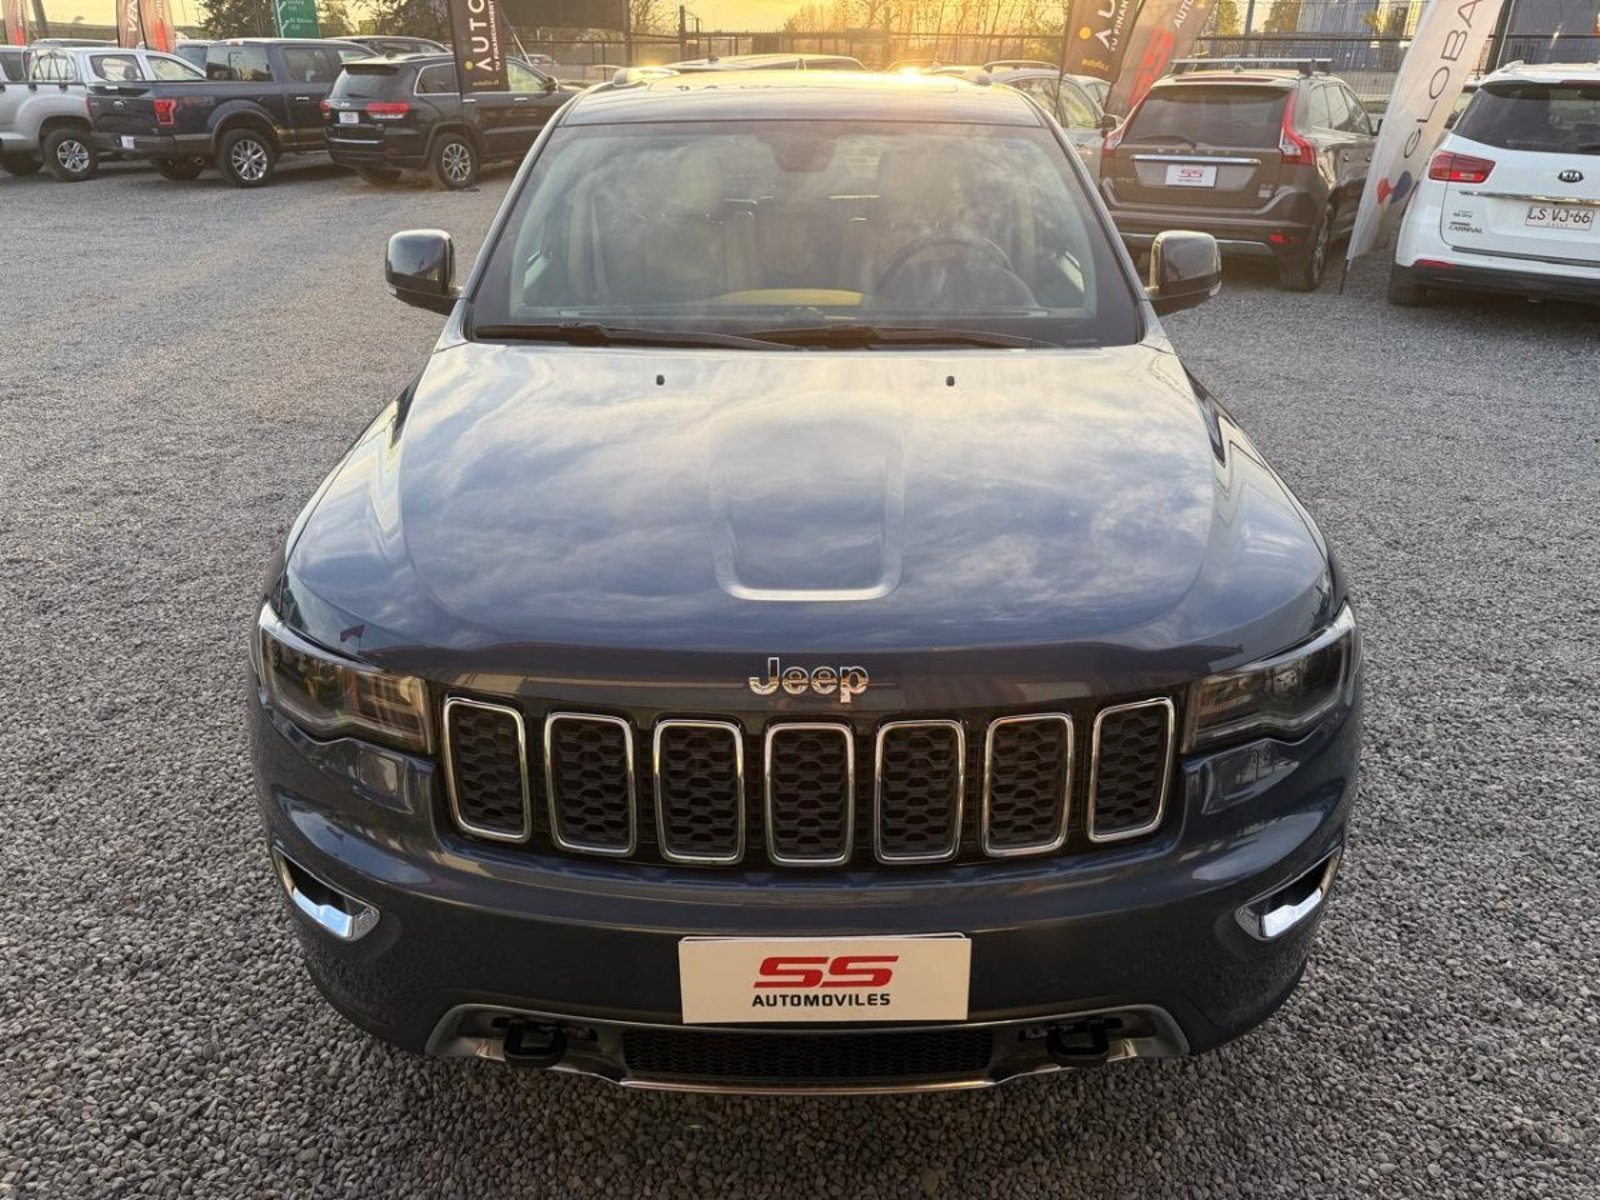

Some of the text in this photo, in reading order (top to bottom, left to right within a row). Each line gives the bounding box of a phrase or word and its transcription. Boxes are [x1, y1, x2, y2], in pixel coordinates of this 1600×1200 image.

[1561, 171, 1580, 181] KIA
[748, 657, 869, 703] Jeep
[753, 956, 899, 988] SS
[752, 993, 891, 1007] AUTOMOVILES
